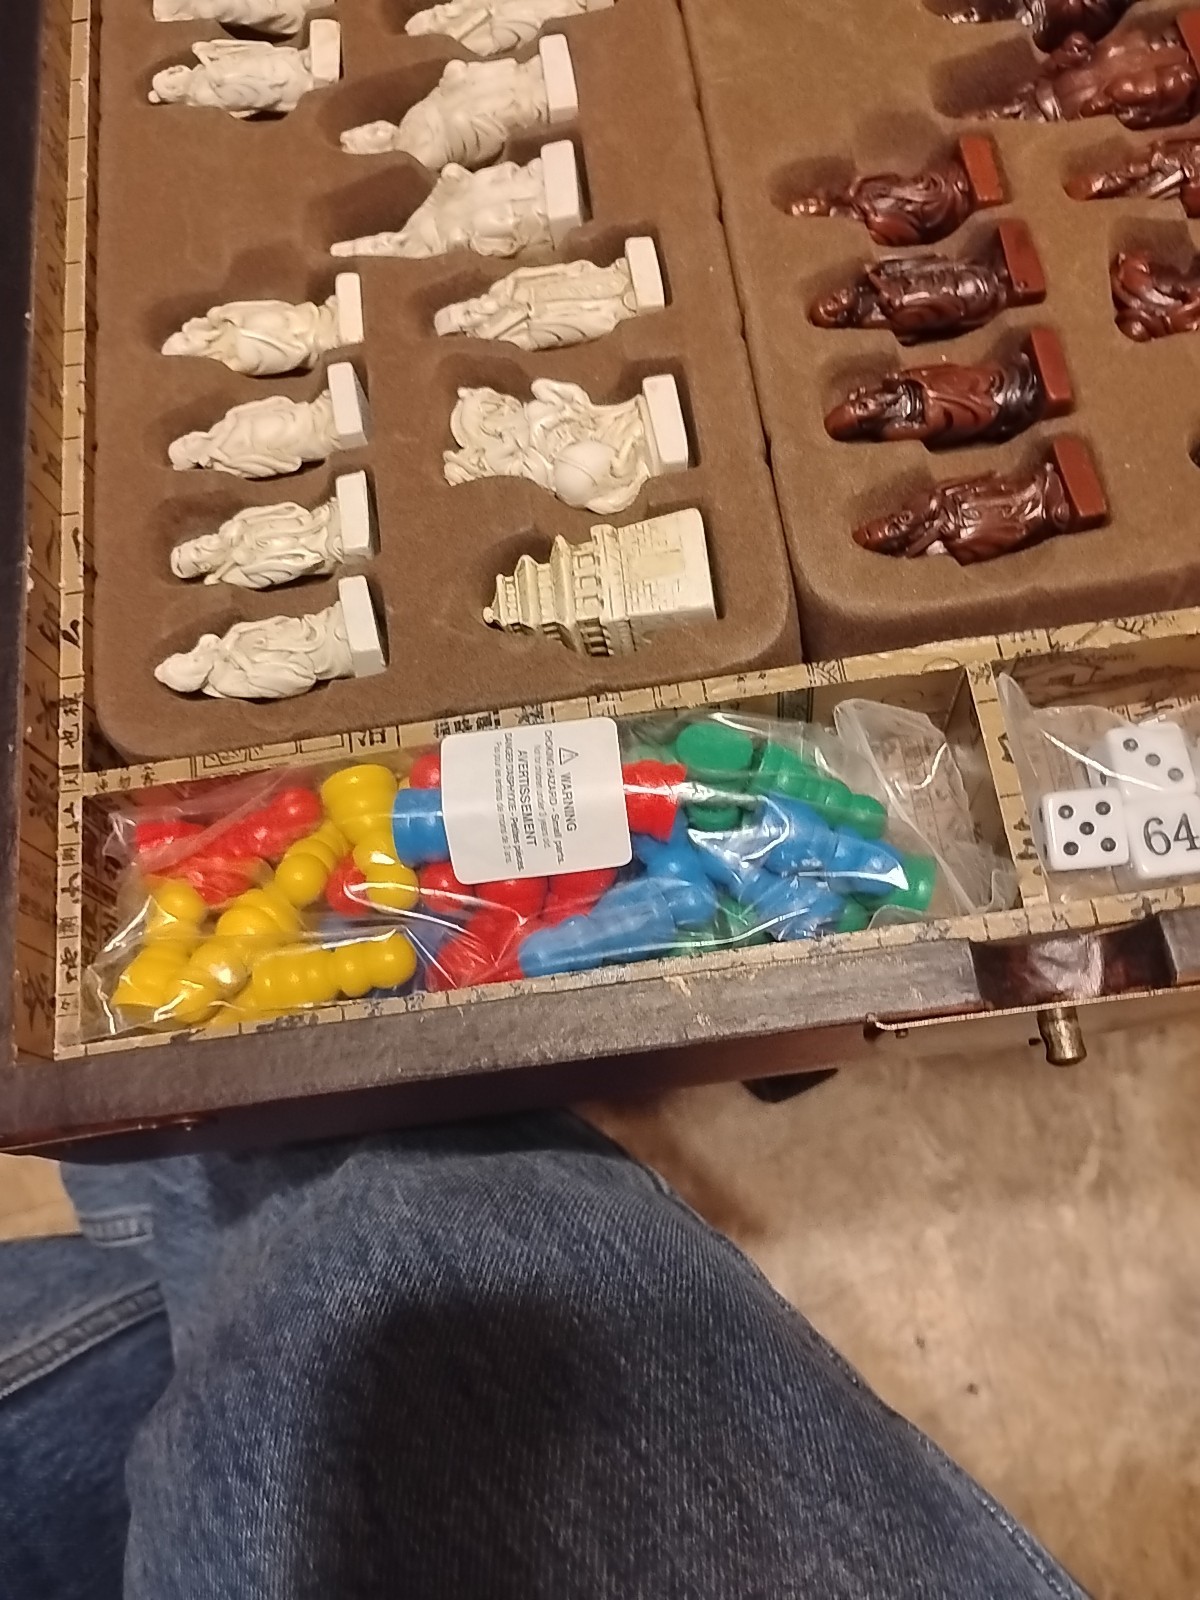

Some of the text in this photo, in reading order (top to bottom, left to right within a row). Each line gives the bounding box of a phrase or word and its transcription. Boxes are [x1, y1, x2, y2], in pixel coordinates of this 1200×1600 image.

[518, 749, 537, 847] AVERTISSEMENT
[546, 767, 558, 806] HAZARD
[560, 772, 577, 832] WARNING
[551, 814, 562, 838] Small
[1143, 813, 1200, 855] 64
